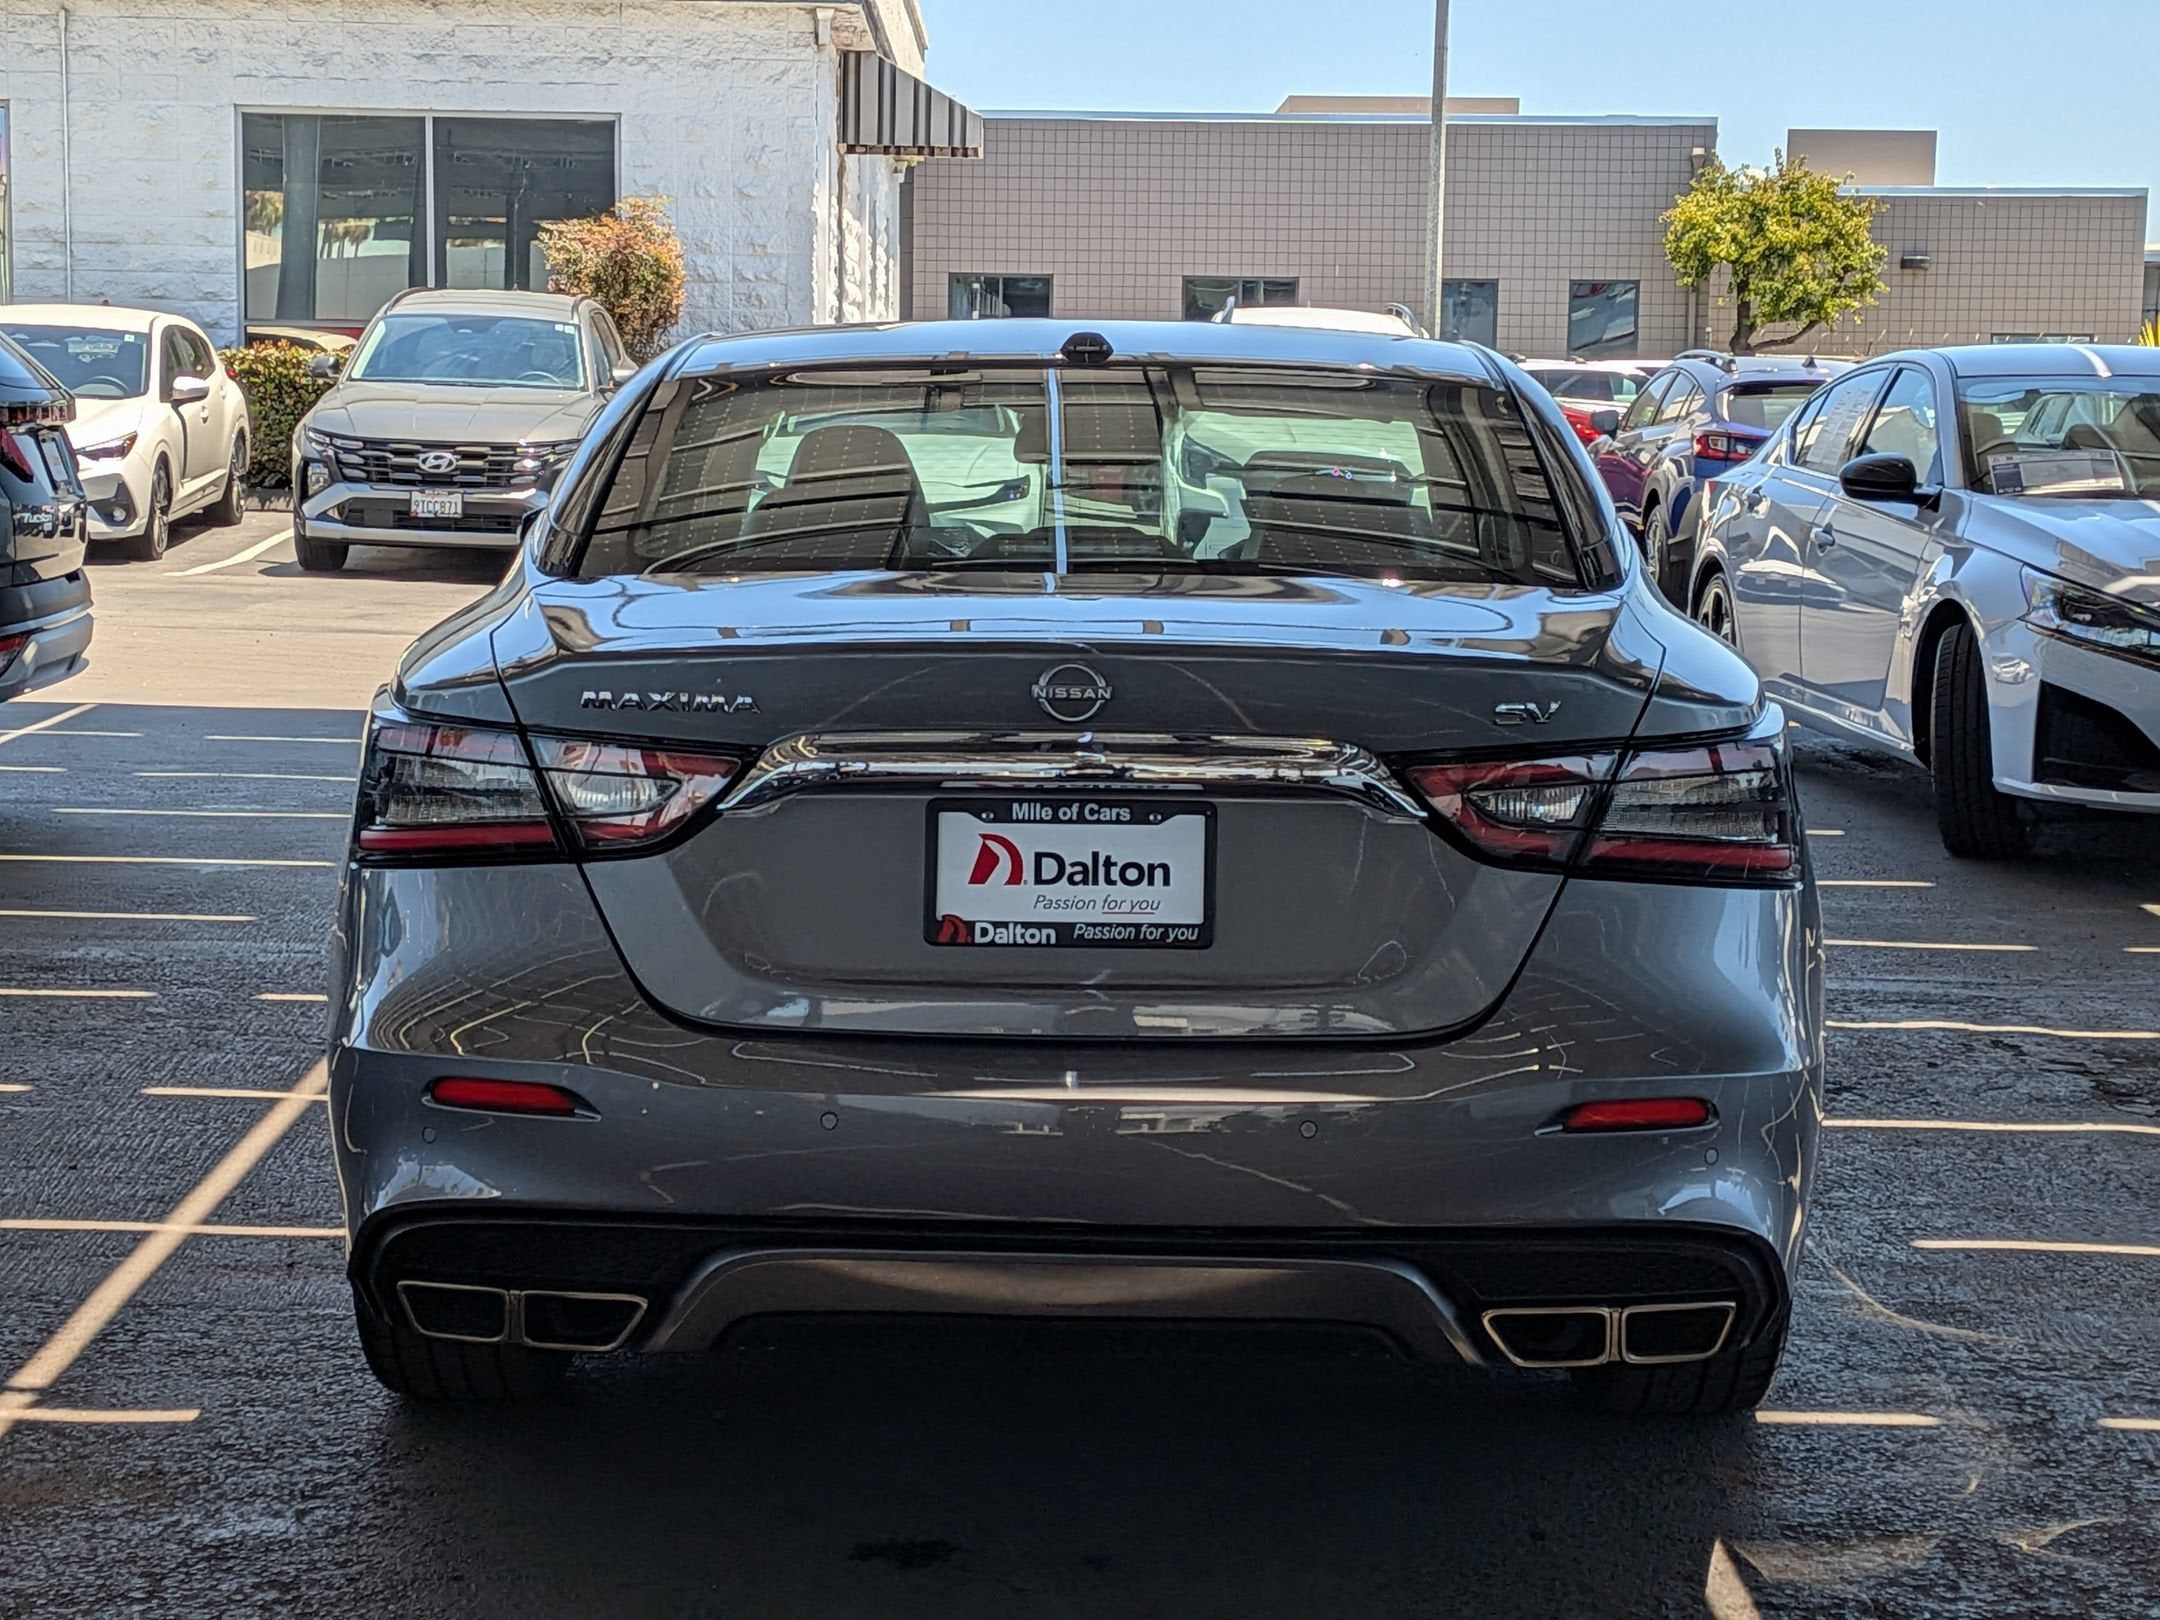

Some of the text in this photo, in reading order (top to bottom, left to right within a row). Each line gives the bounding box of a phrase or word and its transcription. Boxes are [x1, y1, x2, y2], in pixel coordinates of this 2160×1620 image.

[580, 690, 760, 713] MAXIMA
[1032, 684, 1112, 699] NISSAN
[1495, 701, 1561, 724] SV
[1012, 802, 1131, 821] Mile of Cars
[1033, 851, 1171, 887] Dalton
[1033, 895, 1160, 912] Passion for you
[974, 922, 1056, 943] Dalton
[1072, 923, 1198, 942] Passion for you
